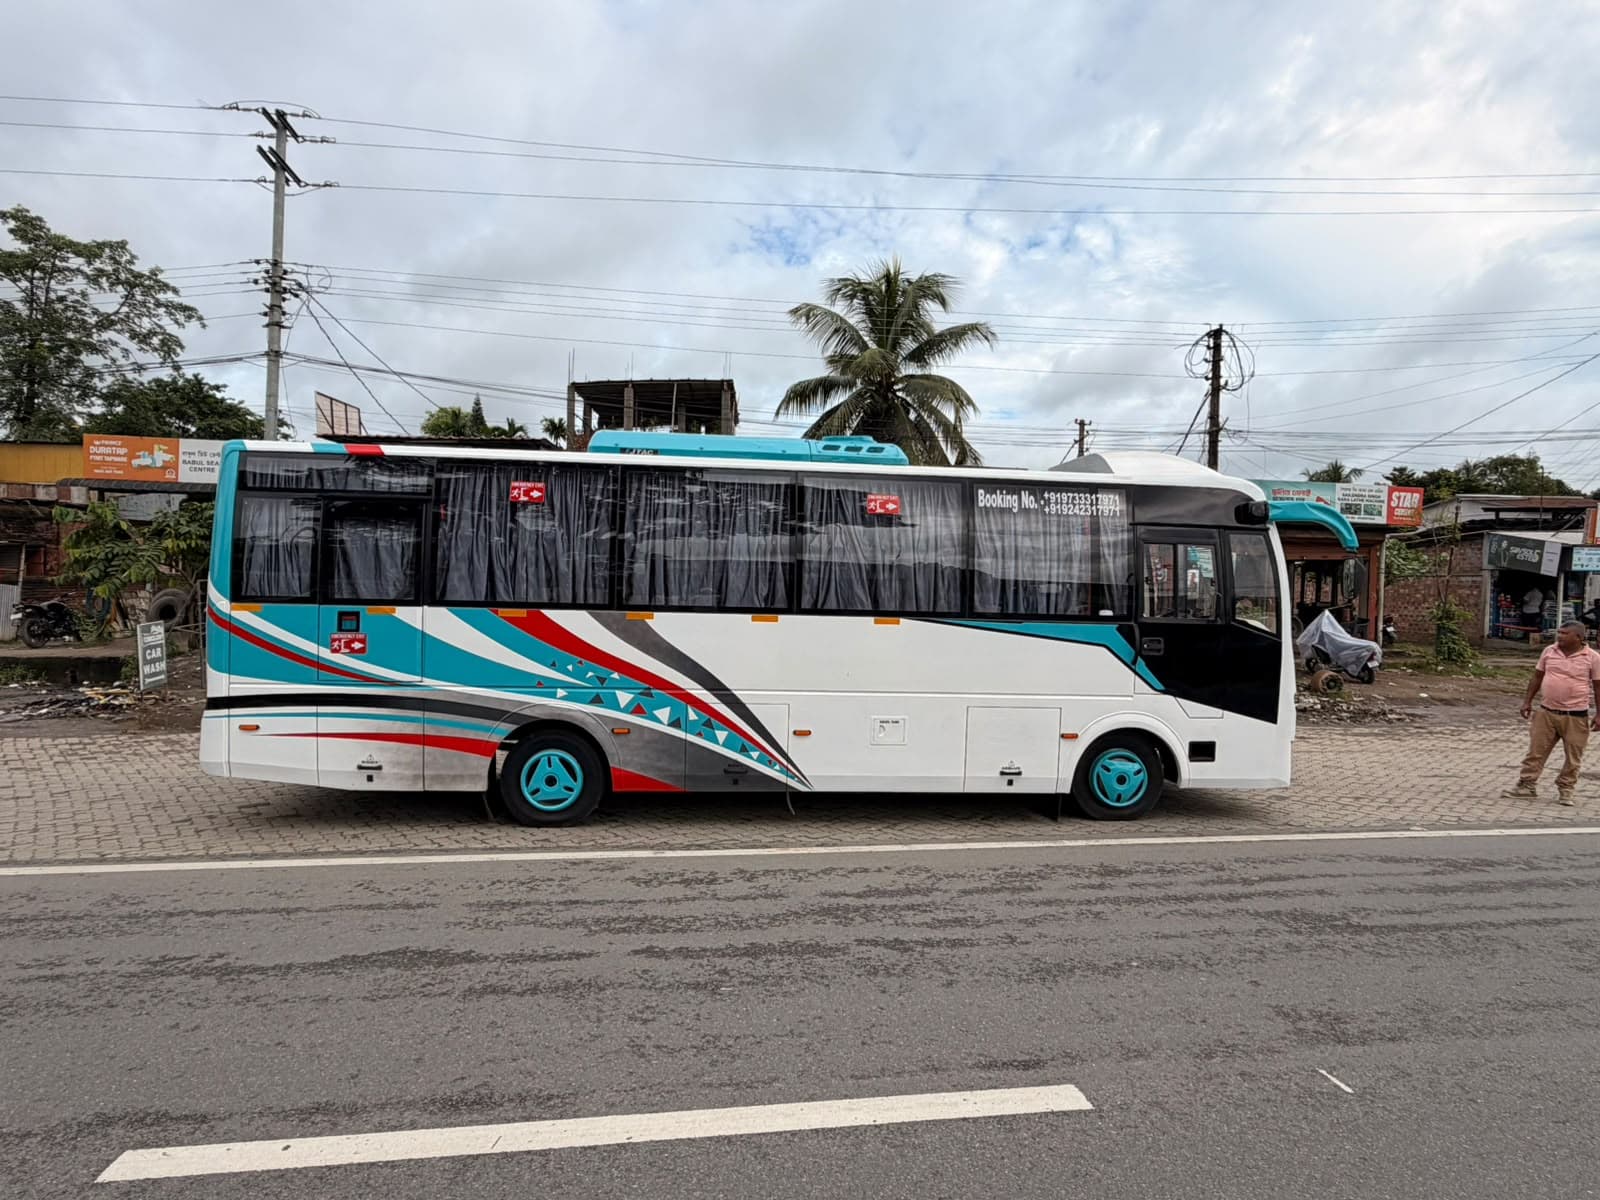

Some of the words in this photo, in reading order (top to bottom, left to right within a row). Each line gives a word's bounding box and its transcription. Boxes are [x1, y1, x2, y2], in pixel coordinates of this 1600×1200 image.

[89, 445, 128, 456] DURATAP
[977, 488, 1019, 513] Booking
[1020, 490, 1038, 509] No.
[1390, 491, 1420, 508] STAR
[145, 648, 161, 660] CAR
[143, 661, 166, 675] WASH
